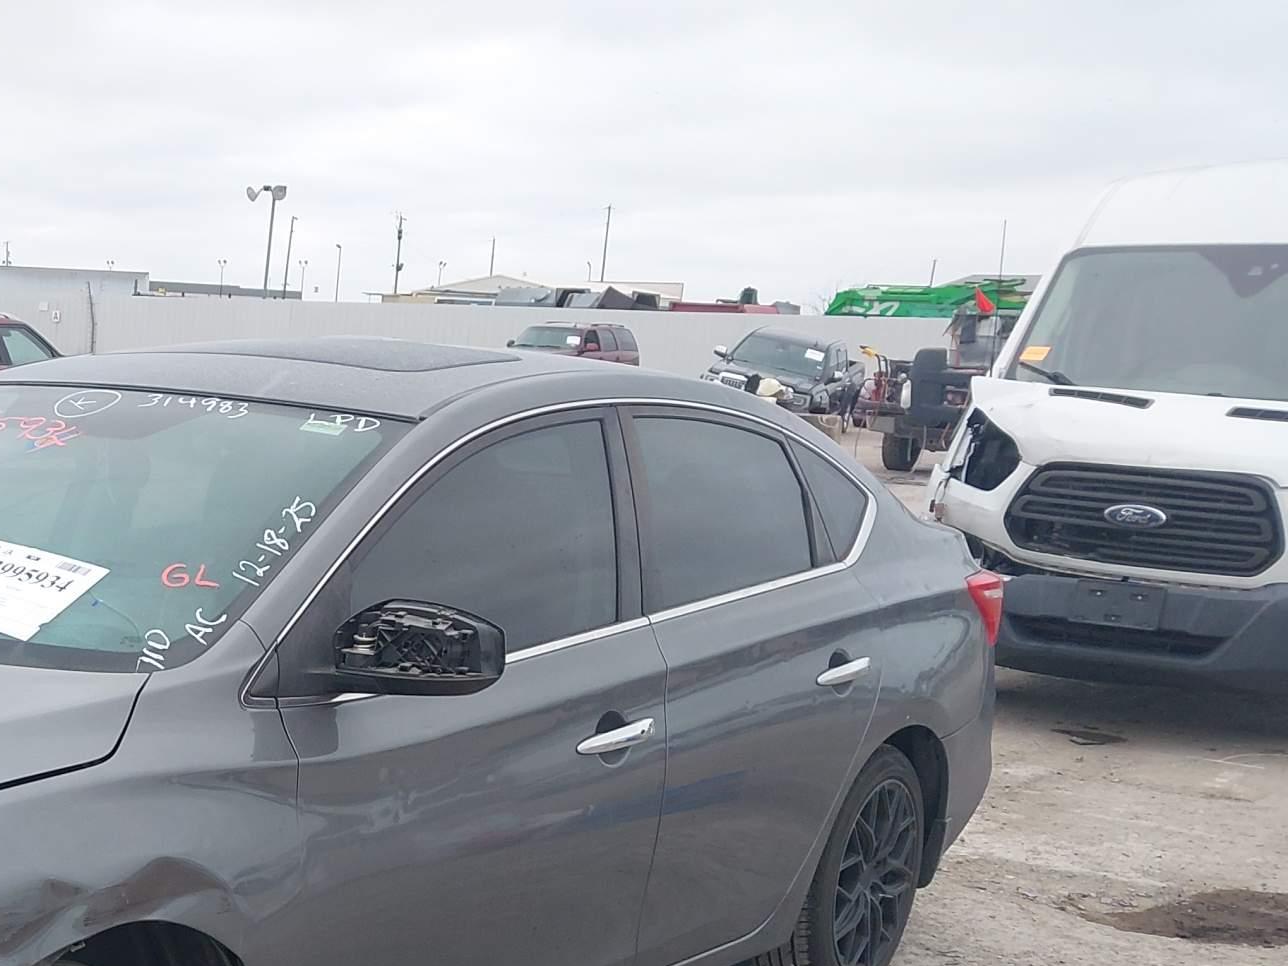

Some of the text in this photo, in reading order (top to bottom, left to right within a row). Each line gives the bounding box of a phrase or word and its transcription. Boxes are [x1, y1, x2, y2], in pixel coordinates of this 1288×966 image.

[137, 393, 249, 418] 314983
[232, 496, 316, 586] 12-18-25
[162, 563, 220, 588] GL
[184, 607, 227, 646] AC
